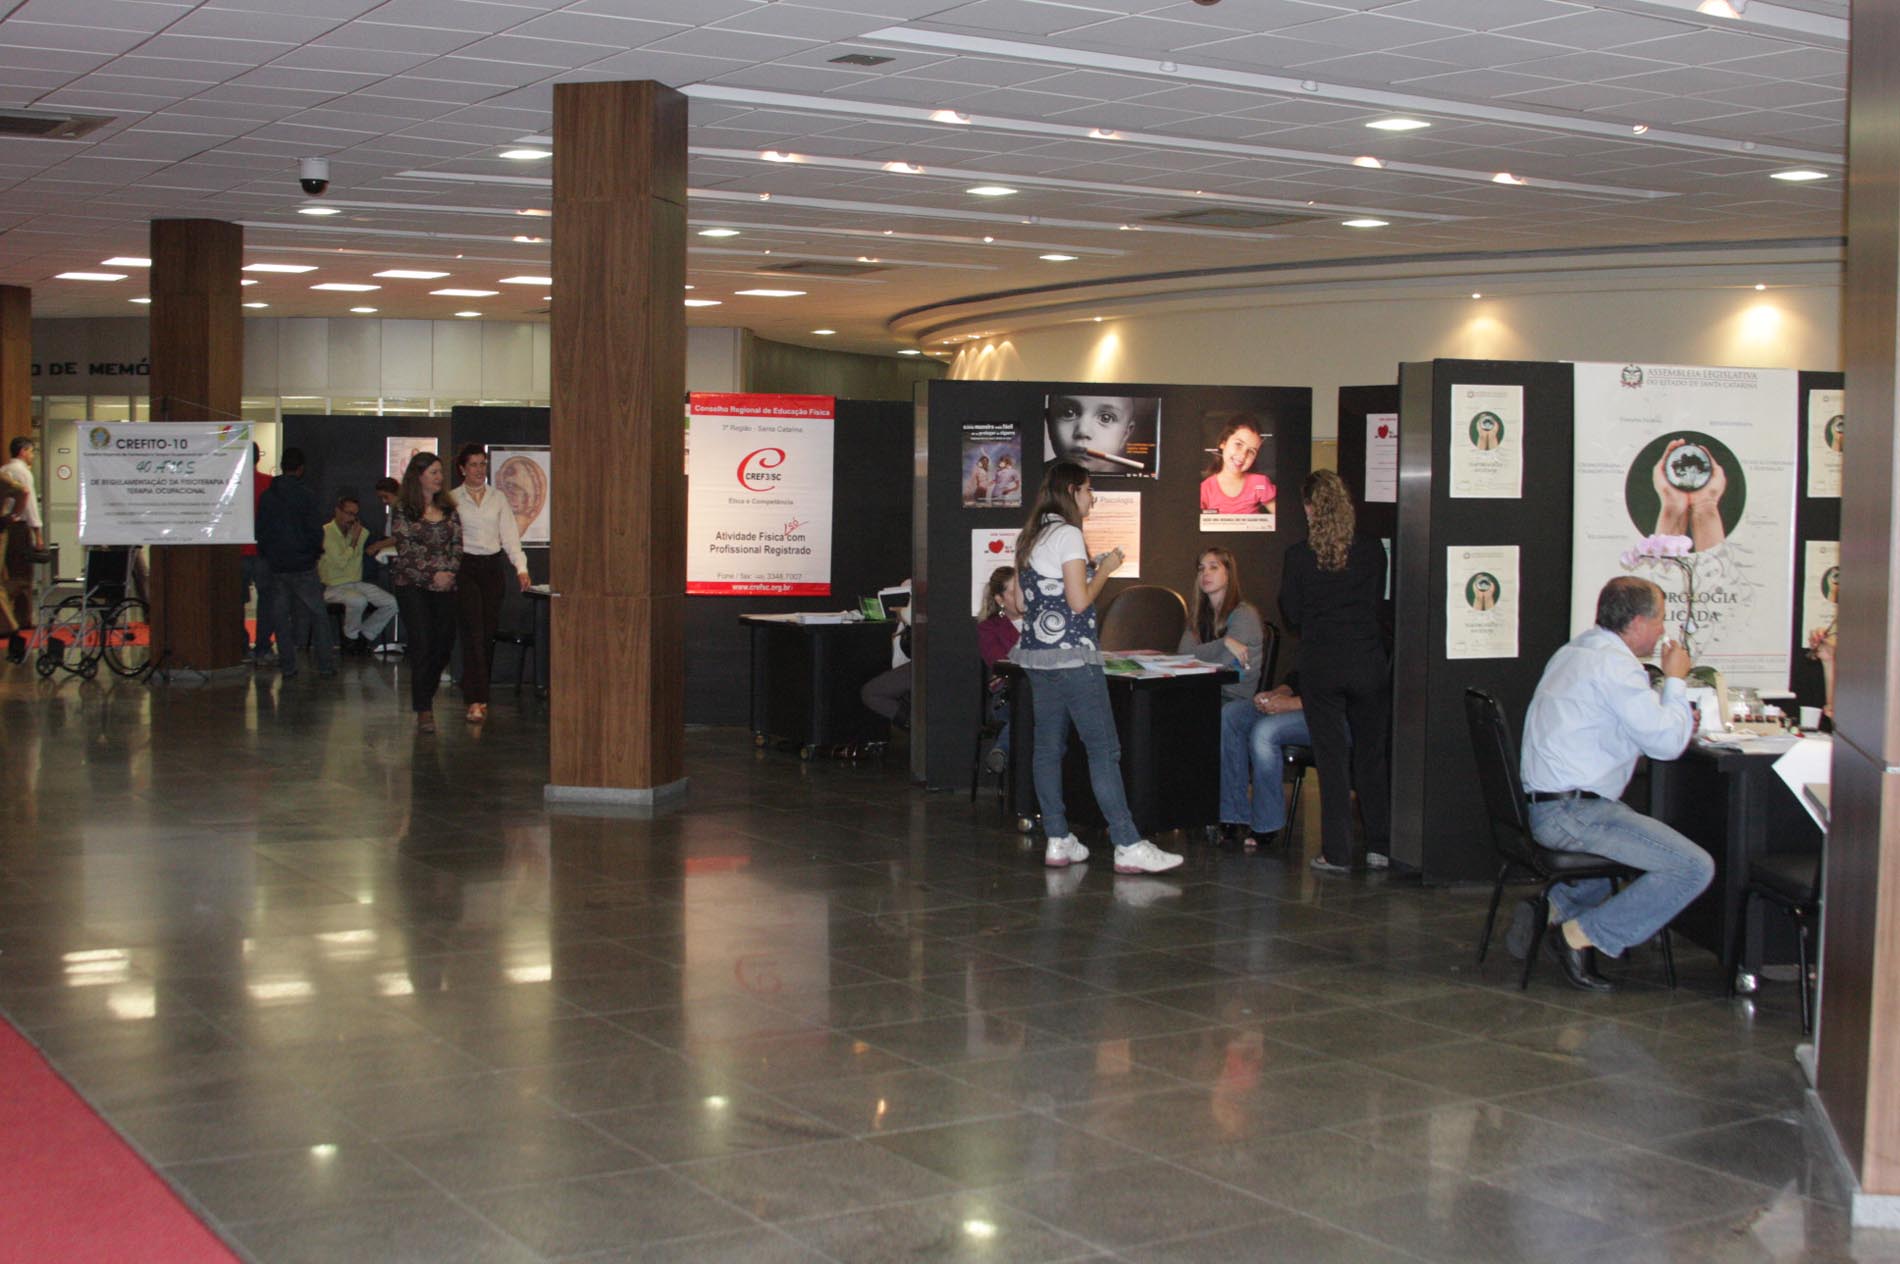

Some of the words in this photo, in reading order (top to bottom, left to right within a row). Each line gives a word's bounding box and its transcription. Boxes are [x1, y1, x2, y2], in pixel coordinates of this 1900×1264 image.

[49, 362, 78, 376] DE
[1648, 369, 1700, 378] ASSEMBLEIA
[1703, 369, 1758, 380] LEGISLATIVA
[1660, 379, 1688, 387] ESTADO
[1701, 380, 1722, 388] SANTA
[1724, 381, 1758, 389] CATARINA
[695, 404, 728, 413] Conselho
[730, 405, 761, 415] Regional
[773, 407, 808, 416] Educação
[116, 438, 188, 449] CREFITO-10
[127, 486, 153, 495] TERAPIA
[156, 486, 206, 495] OCUPACIONAL
[715, 531, 756, 541] Atividade
[787, 533, 806, 542] com
[709, 543, 762, 554] Profissional
[764, 544, 812, 557] Registrado
